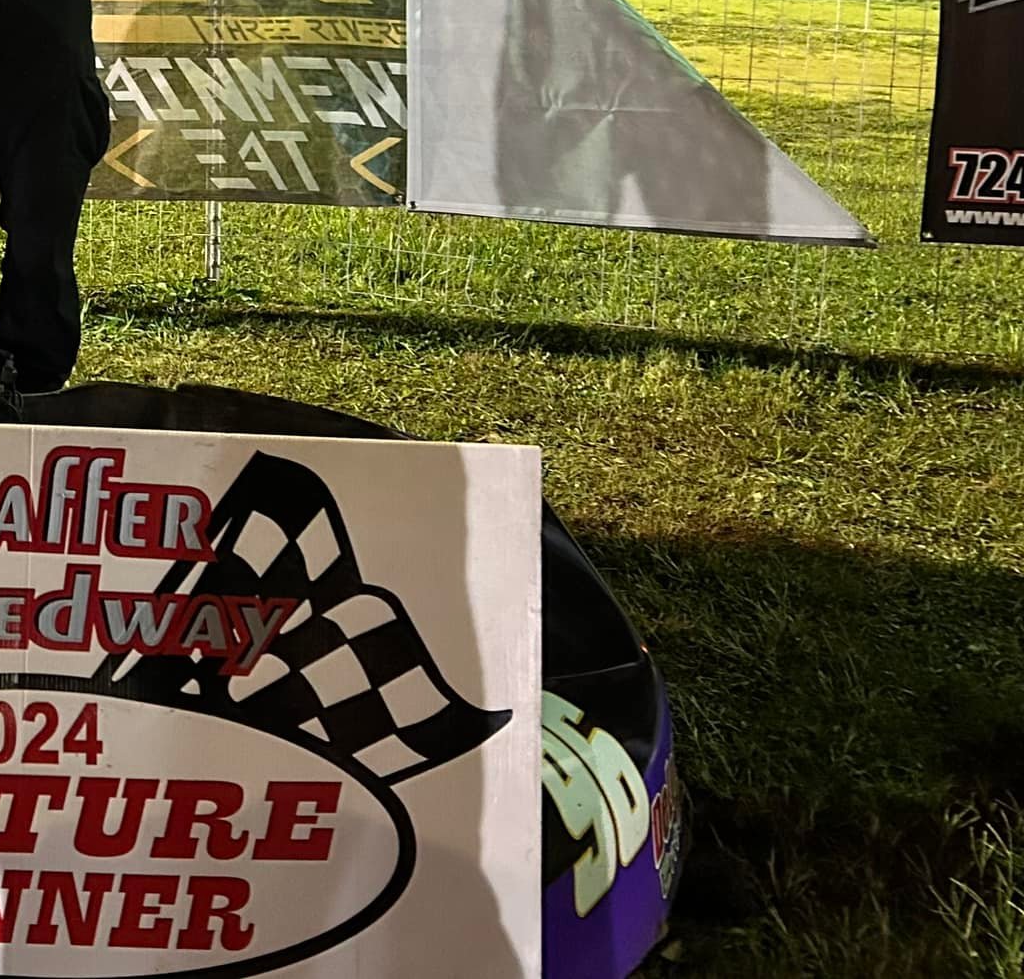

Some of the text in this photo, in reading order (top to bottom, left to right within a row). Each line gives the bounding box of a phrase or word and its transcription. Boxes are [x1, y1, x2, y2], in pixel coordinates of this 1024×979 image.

[204, 18, 301, 41] THREE
[95, 55, 408, 130] AINMEN
[949, 148, 1024, 202] 724
